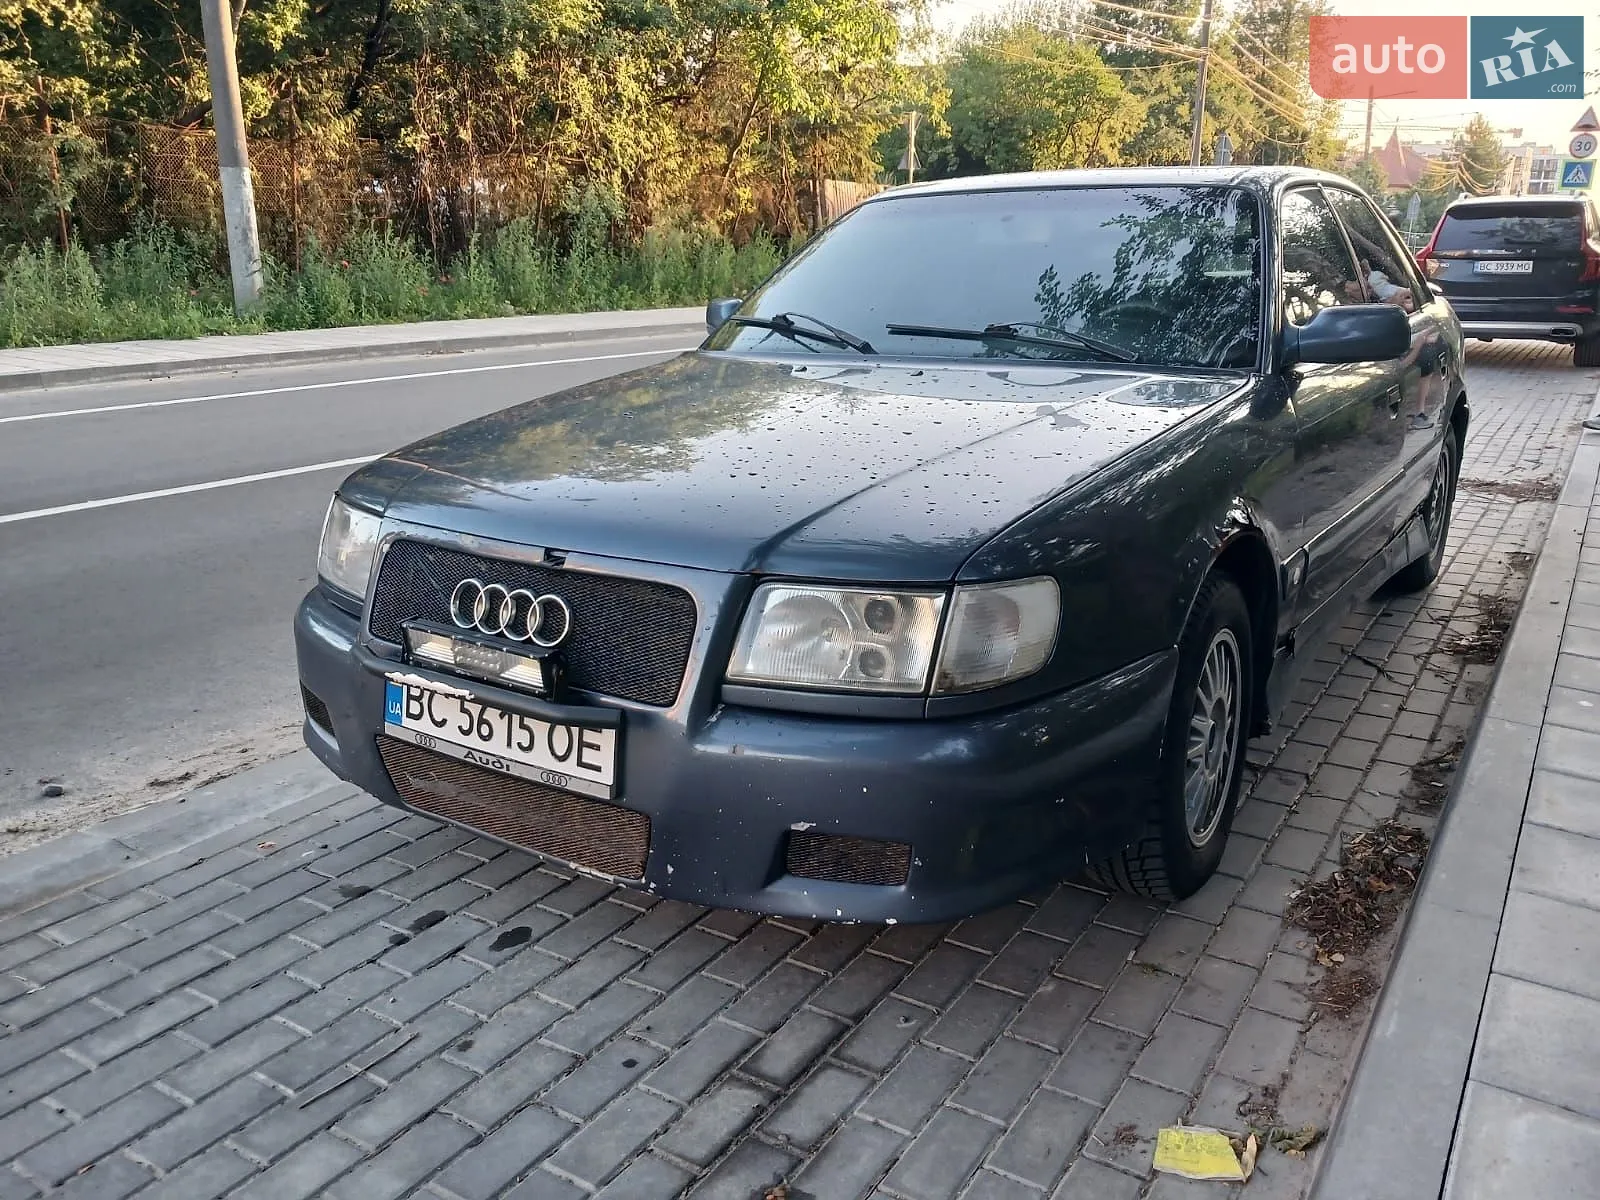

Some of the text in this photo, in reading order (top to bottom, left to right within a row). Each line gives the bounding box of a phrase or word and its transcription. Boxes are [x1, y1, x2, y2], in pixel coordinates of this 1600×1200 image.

[1575, 141, 1592, 152] 30
[1480, 262, 1492, 271] BC
[1495, 262, 1515, 271] 3939
[388, 700, 402, 717] UA
[405, 686, 602, 773] BC 5615 OE
[464, 750, 511, 772] Audi
